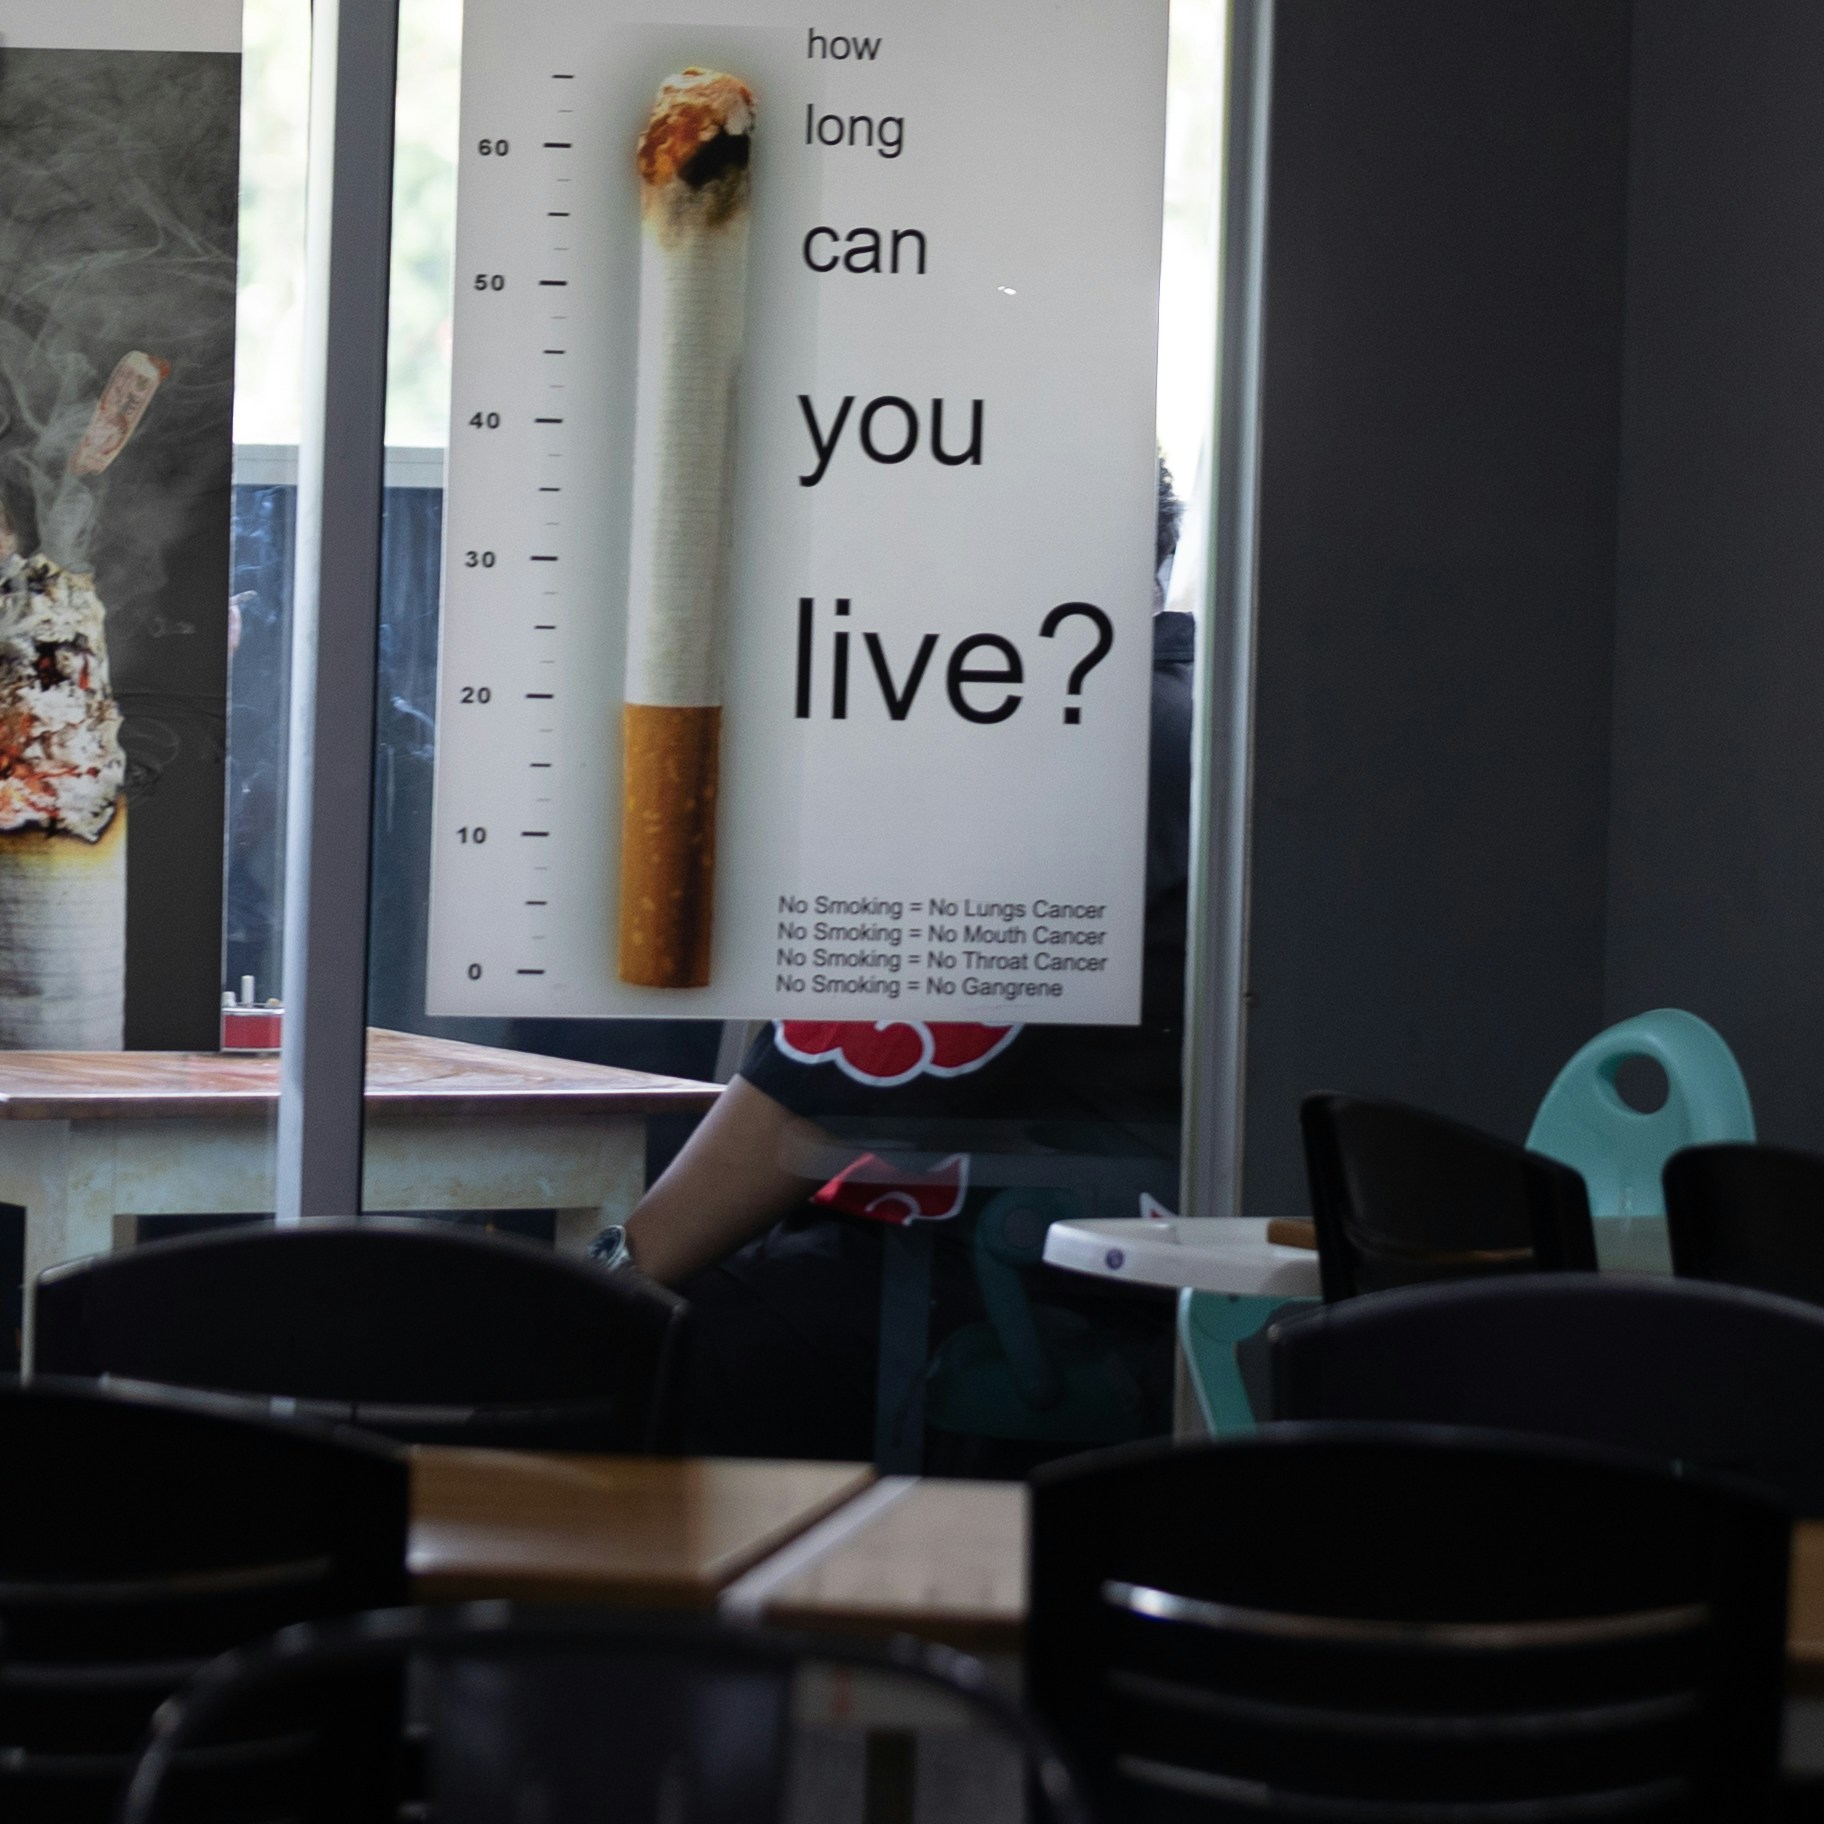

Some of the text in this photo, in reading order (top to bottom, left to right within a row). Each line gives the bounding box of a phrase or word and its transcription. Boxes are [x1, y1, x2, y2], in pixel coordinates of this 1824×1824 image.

[807, 26, 882, 62] how
[805, 103, 905, 159] long
[477, 138, 510, 157] 60
[802, 225, 927, 275] can
[474, 273, 506, 292] 50
[468, 411, 501, 430] 40
[797, 393, 985, 488] you
[464, 550, 496, 569] 30
[795, 597, 1115, 727] live?
[460, 686, 492, 705] 20
[456, 826, 487, 845] 10
[778, 895, 808, 914] No
[814, 895, 903, 920] Smoking
[928, 898, 958, 917] No
[964, 899, 1026, 922] Lungs
[1032, 900, 1107, 920] Cancer
[777, 922, 807, 941] No
[813, 922, 902, 946] Smoking
[928, 925, 958, 944] No
[963, 925, 1026, 944] Mouth
[1032, 926, 1107, 946] Cancer
[467, 962, 483, 981] 0
[776, 948, 806, 967] No
[812, 948, 901, 973] Smoking
[927, 950, 957, 969] No
[963, 950, 1028, 971] Throat
[1033, 952, 1108, 972] Cancer
[776, 974, 805, 993] No
[811, 974, 900, 999] Smoking
[926, 977, 956, 995] No
[961, 977, 1064, 1000] Gangrene
